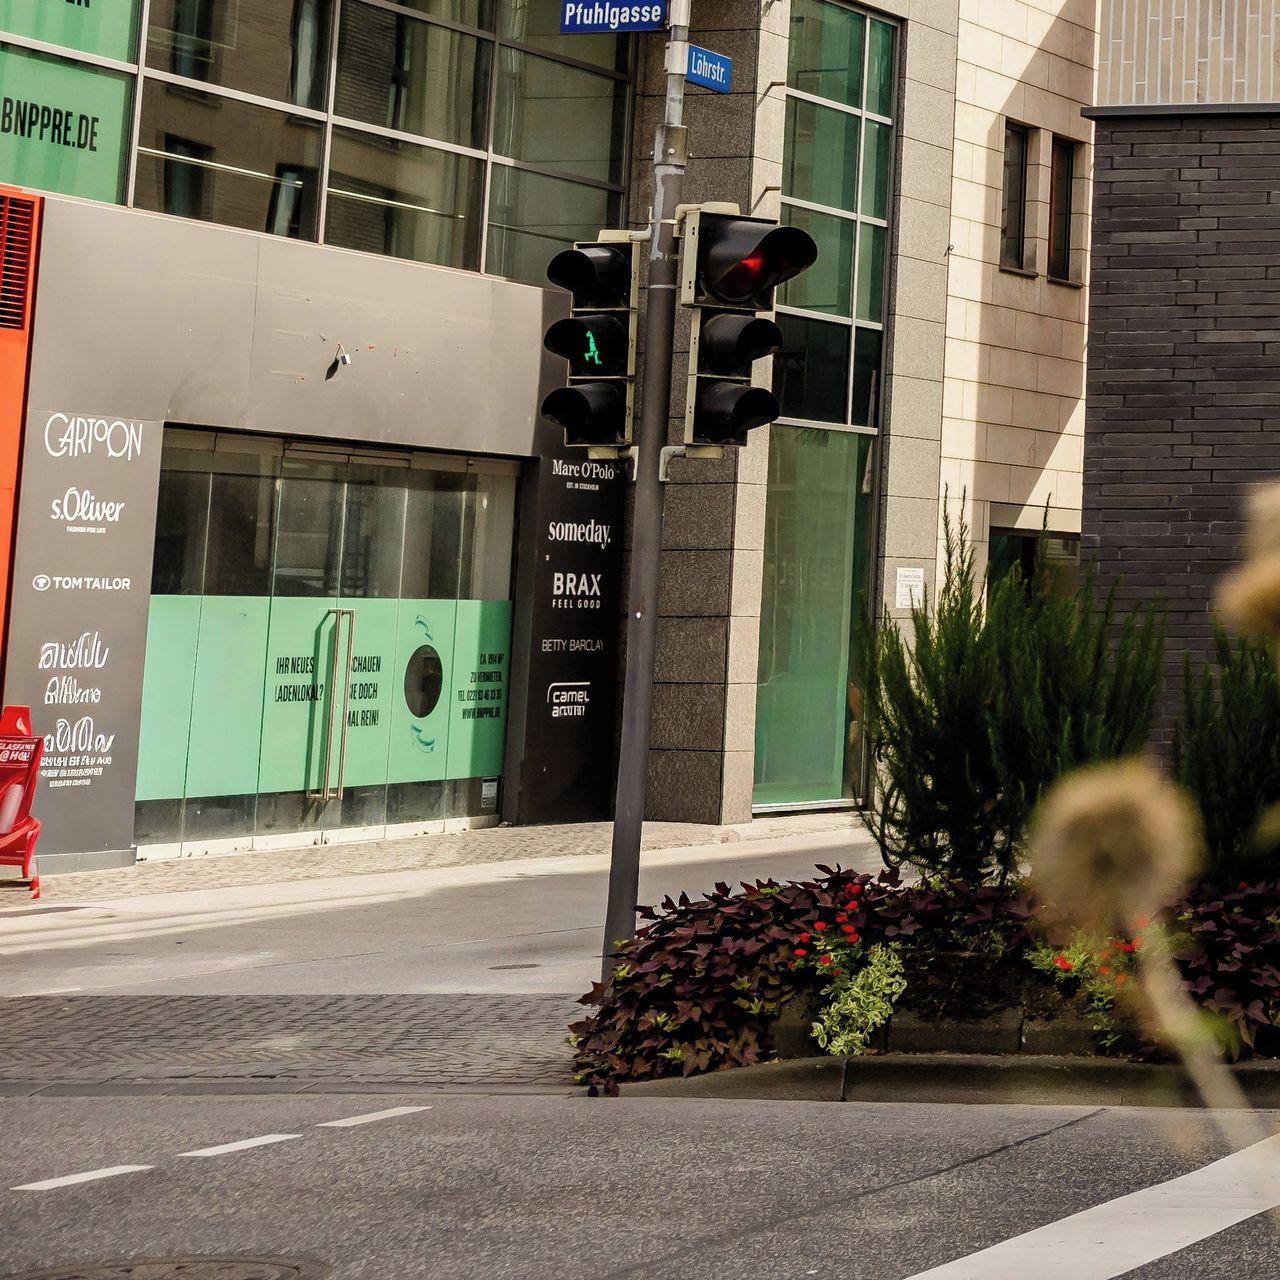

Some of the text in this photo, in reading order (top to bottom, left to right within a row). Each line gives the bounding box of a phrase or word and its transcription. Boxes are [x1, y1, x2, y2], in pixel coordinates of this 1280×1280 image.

[565, 2, 661, 30] Pfuhlgasse
[691, 53, 726, 84] Löhrstr.
[1, 96, 99, 152] BNPPRE.DE
[44, 412, 143, 461] CARTOON
[552, 459, 614, 479] Marc O'Polo
[51, 487, 125, 522] s.Oliver
[548, 519, 611, 549] someday.
[53, 576, 131, 590] TOM TAILOR
[553, 572, 601, 596] BRAX
[552, 599, 600, 609] FEEL GOOD
[542, 639, 567, 652] BETTY
[276, 656, 315, 674] IHR NEUES
[275, 684, 324, 702] LADENLOKAL?
[358, 683, 378, 700] DOCH
[552, 691, 590, 703] camel
[361, 709, 379, 726] REIN!
